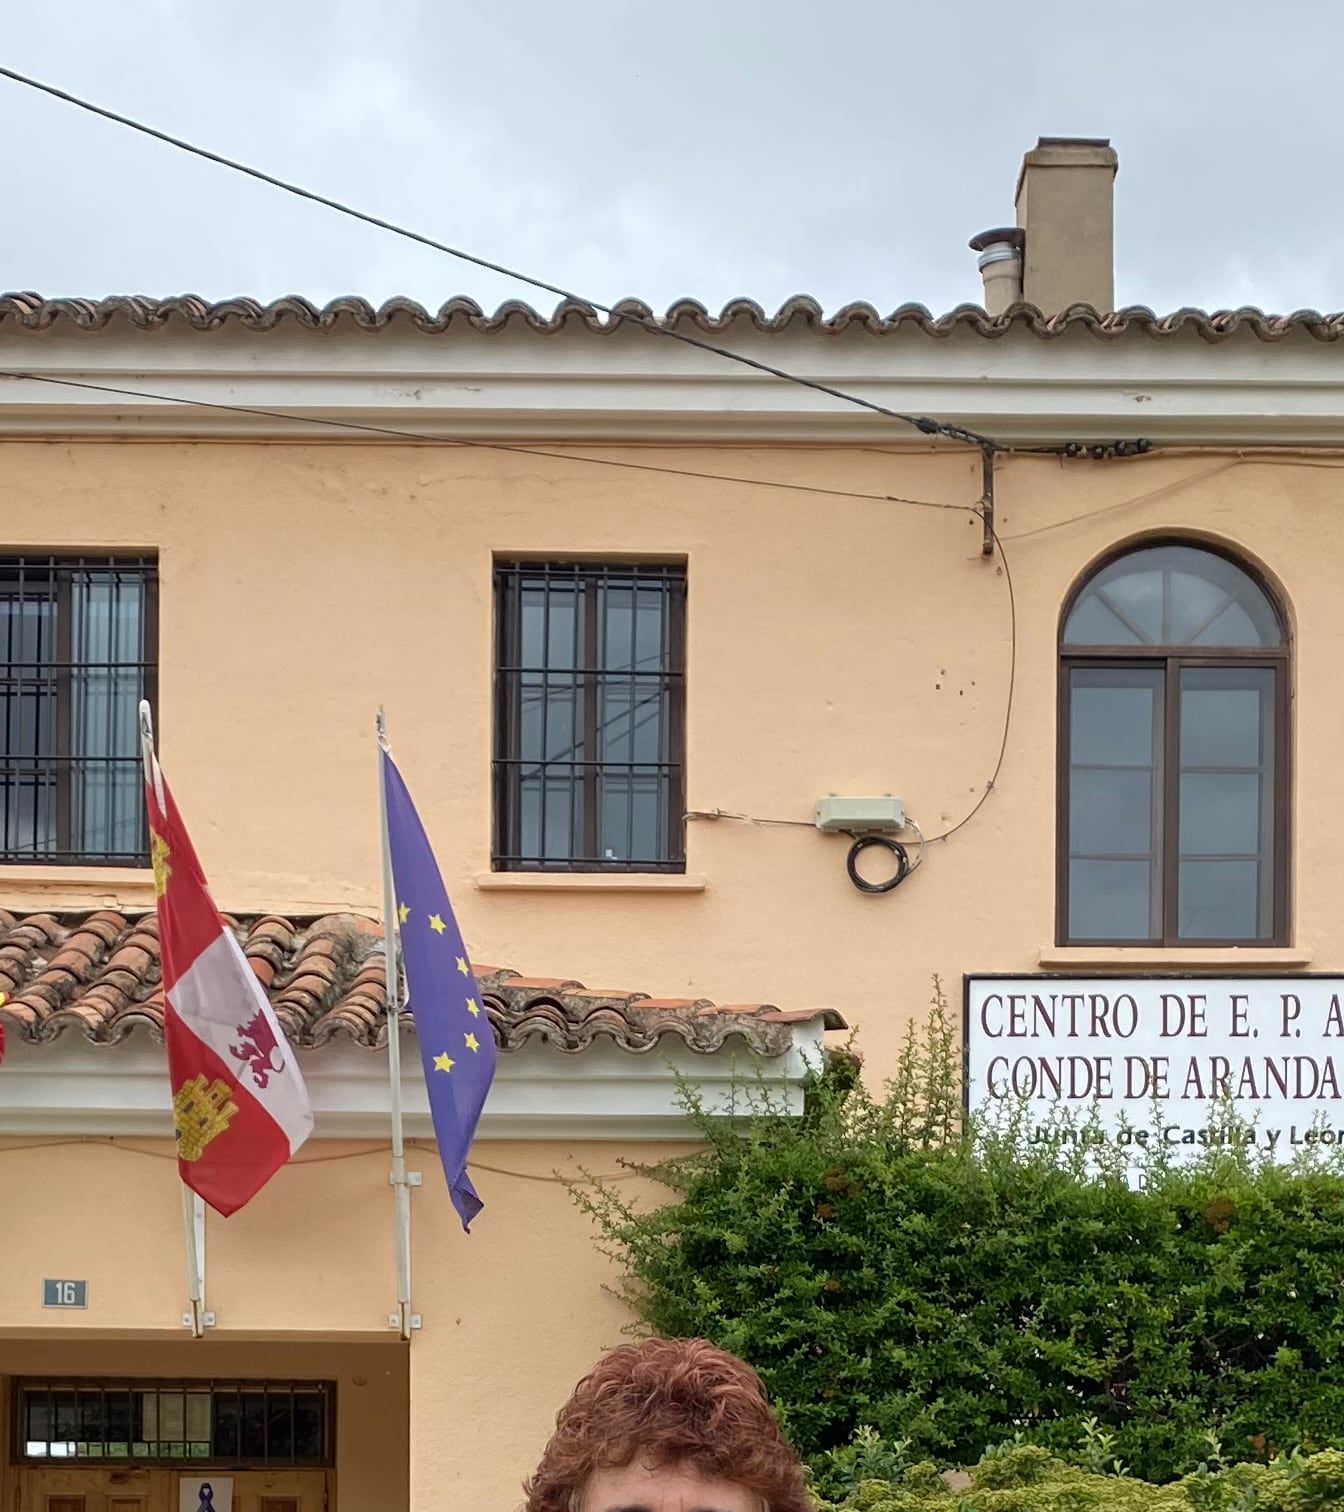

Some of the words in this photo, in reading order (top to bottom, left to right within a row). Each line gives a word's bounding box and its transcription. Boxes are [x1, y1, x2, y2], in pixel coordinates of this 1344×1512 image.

[981, 994, 1138, 1038] CENTRO
[1160, 994, 1207, 1037] DE
[986, 1056, 1113, 1099] CONDE
[1124, 1056, 1171, 1099] DE
[1181, 1056, 1342, 1099] ARANDA
[1116, 1126, 1149, 1146] de
[1266, 1129, 1280, 1150] y
[55, 1281, 76, 1305] 16
